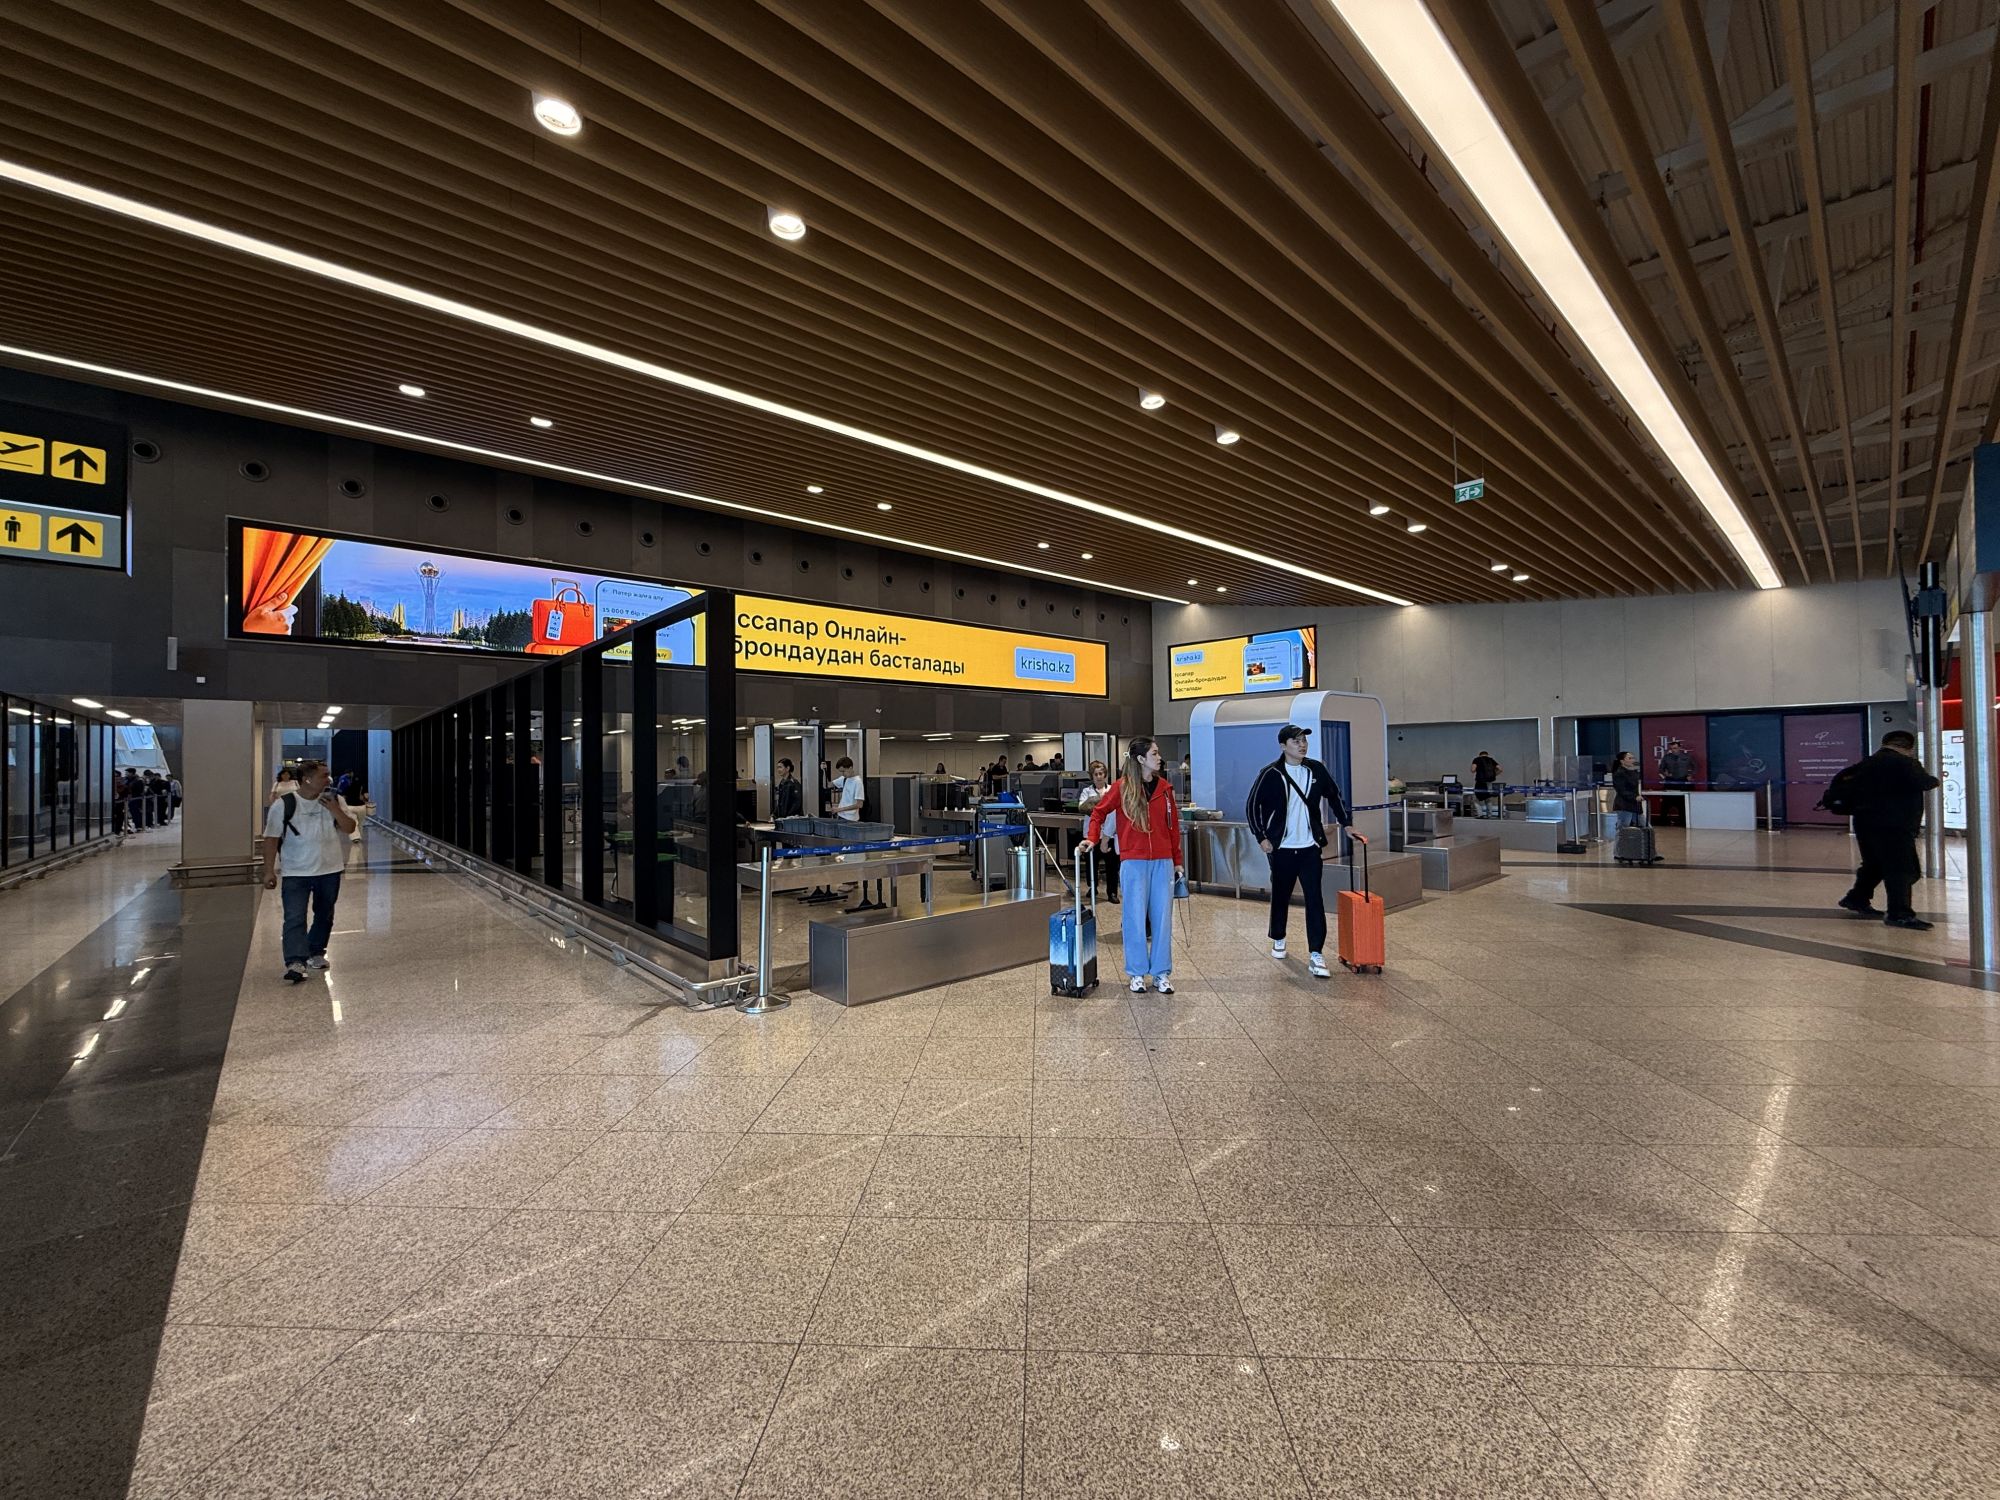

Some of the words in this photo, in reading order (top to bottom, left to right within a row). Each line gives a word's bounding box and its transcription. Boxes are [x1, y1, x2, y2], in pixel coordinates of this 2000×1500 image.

[737, 612, 819, 641] ссапар
[825, 620, 907, 645] Онлайн-
[735, 634, 864, 666] брондаудан
[869, 649, 965, 675] басталады
[1020, 655, 1071, 674] krisha.kz
